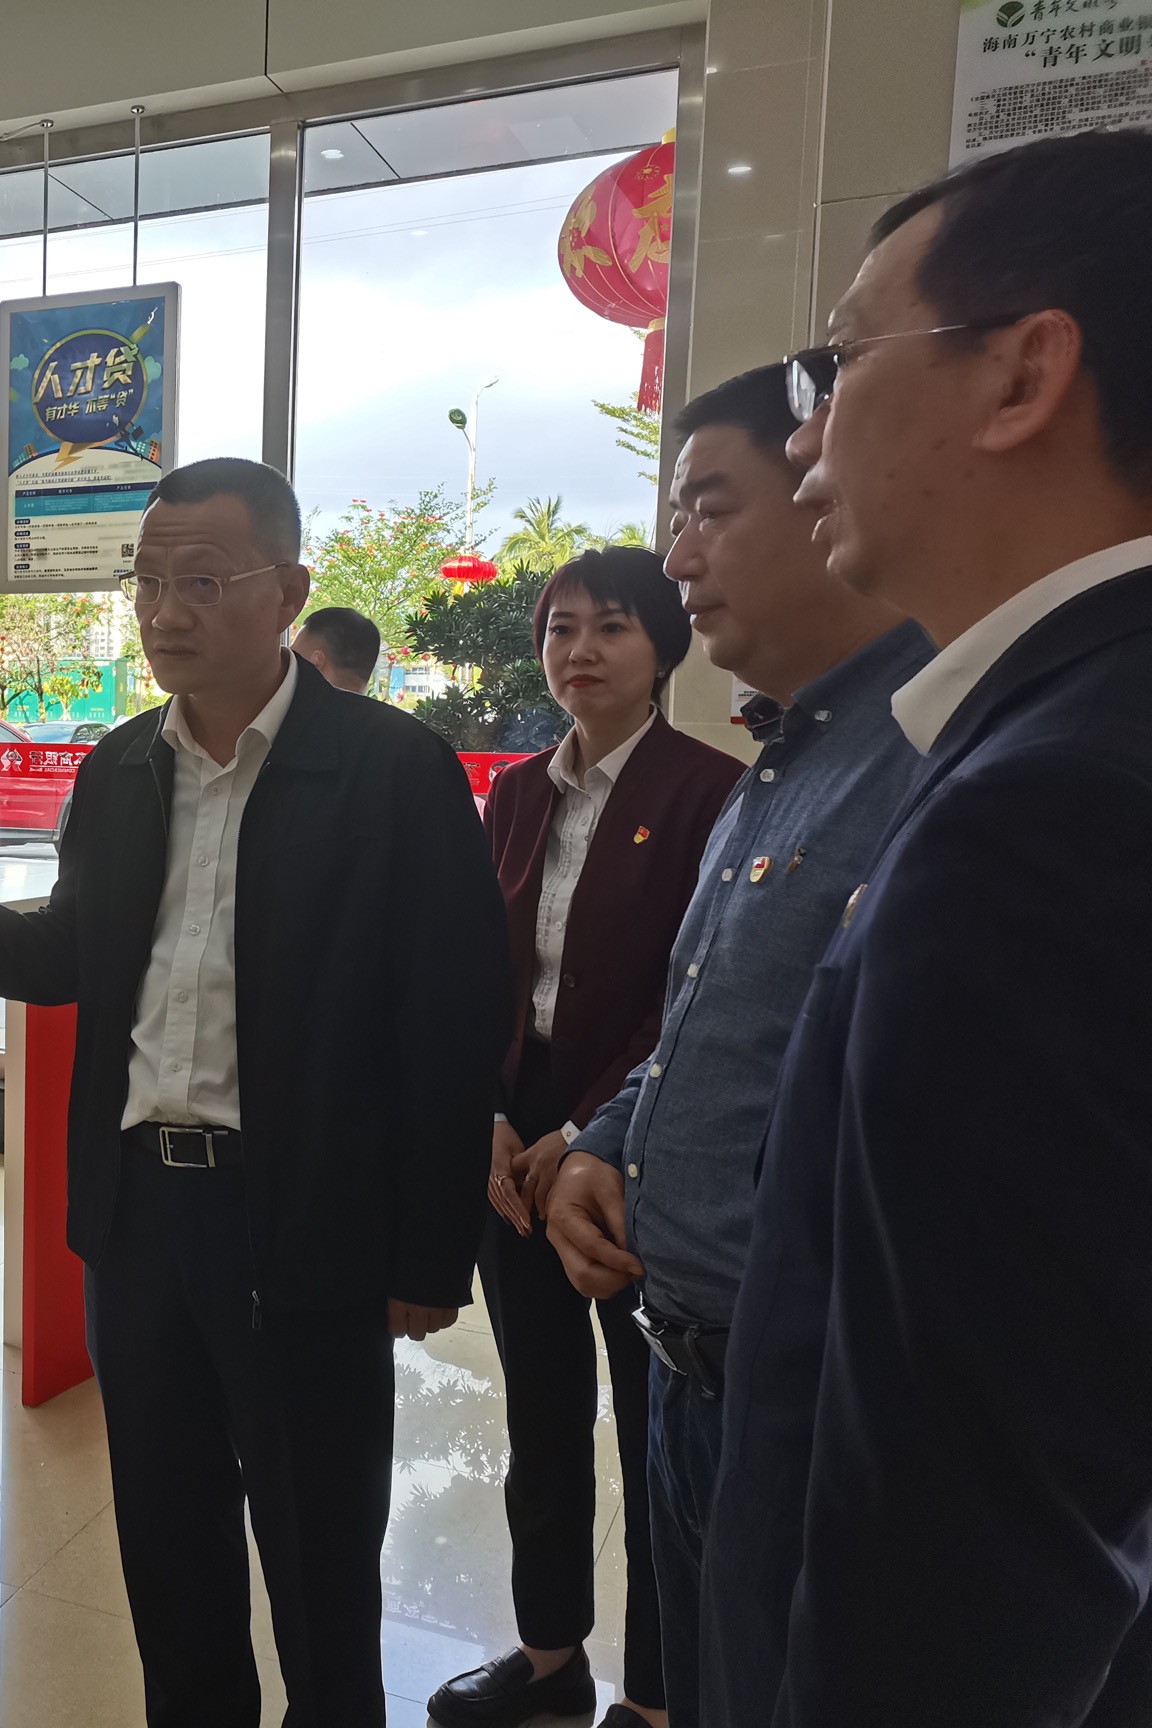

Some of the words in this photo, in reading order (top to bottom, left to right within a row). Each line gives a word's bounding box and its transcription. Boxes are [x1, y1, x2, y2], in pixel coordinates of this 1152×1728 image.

[1024, 33, 1152, 68] “青年文明
[33, 343, 139, 404] 人才贷
[45, 401, 80, 421] 有才华
